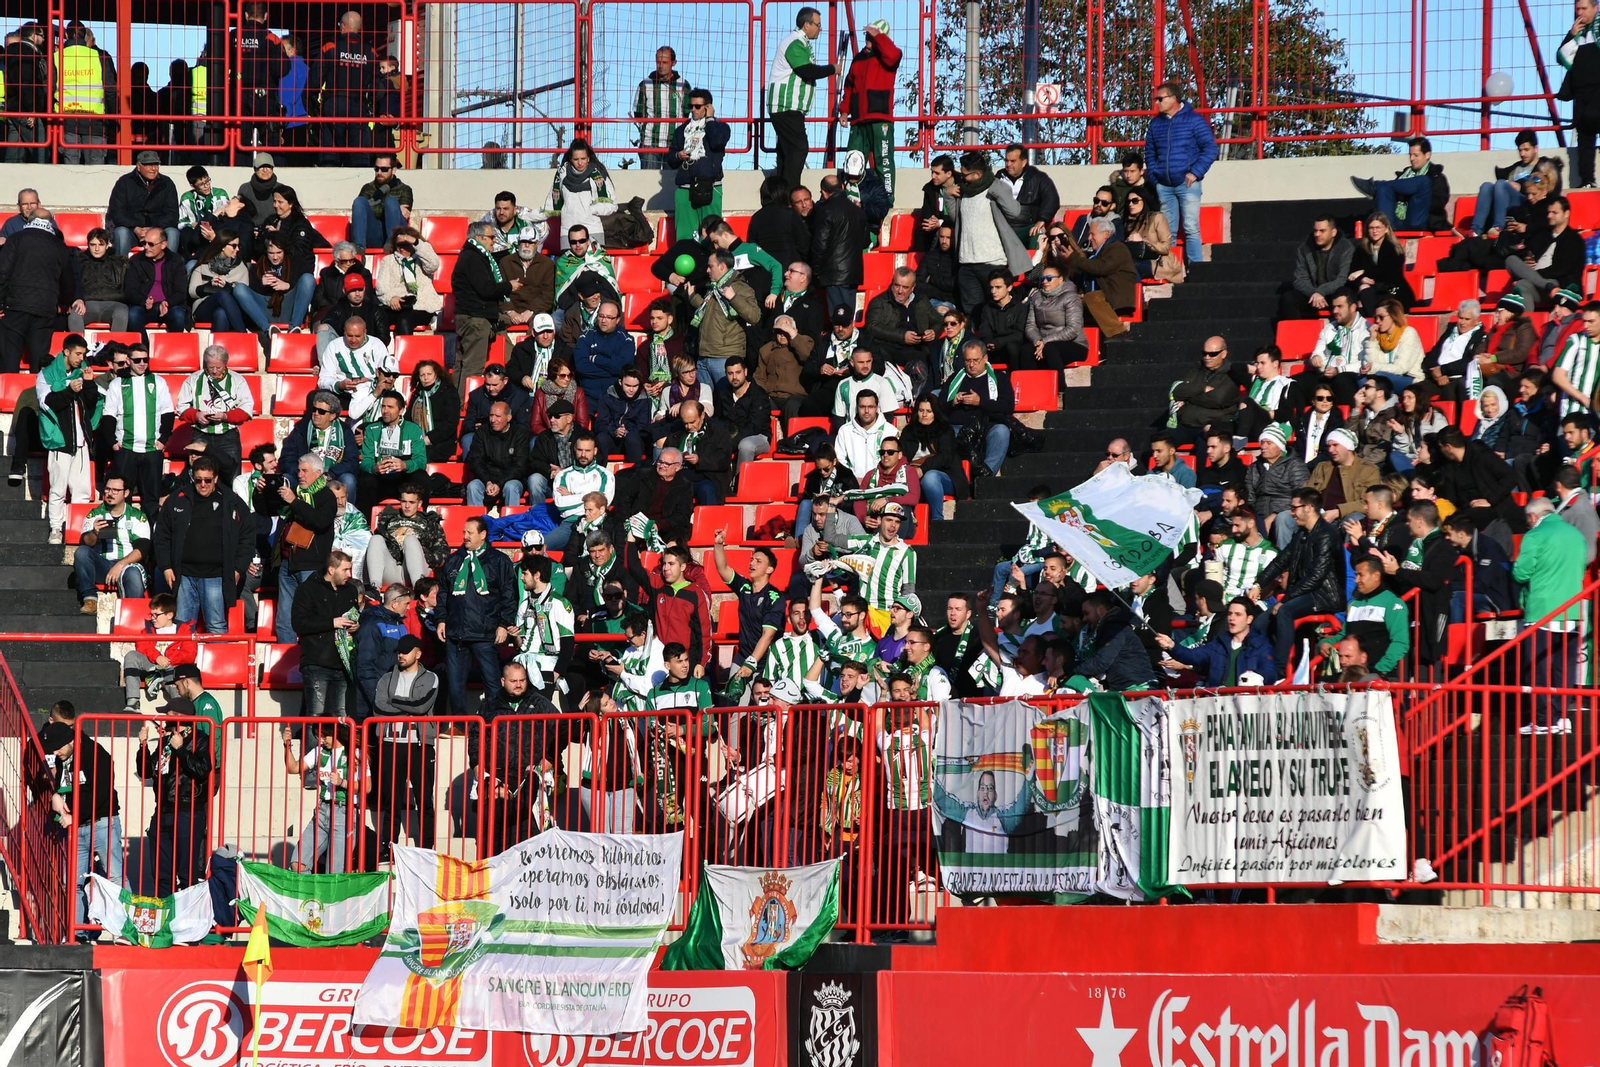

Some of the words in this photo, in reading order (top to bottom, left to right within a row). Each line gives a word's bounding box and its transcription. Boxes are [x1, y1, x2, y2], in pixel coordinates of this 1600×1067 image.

[340, 52, 368, 61] POLICIA
[1207, 705, 1235, 752] PEÑA
[1209, 760, 1224, 798] EL
[1278, 759, 1286, 797] Y
[1290, 758, 1307, 797] SU
[1311, 757, 1351, 796] TRUPE
[1280, 809, 1293, 823] es
[1298, 802, 1351, 831] pasarlo
[1239, 855, 1284, 877] pasión
[1289, 859, 1313, 877] por
[1334, 854, 1397, 870] colores
[548, 896, 571, 916] por
[488, 976, 541, 996] SANGRE
[647, 993, 692, 1008] RUPO
[247, 1012, 475, 1056] BERCOSE
[1148, 987, 1348, 1067] Estrella
